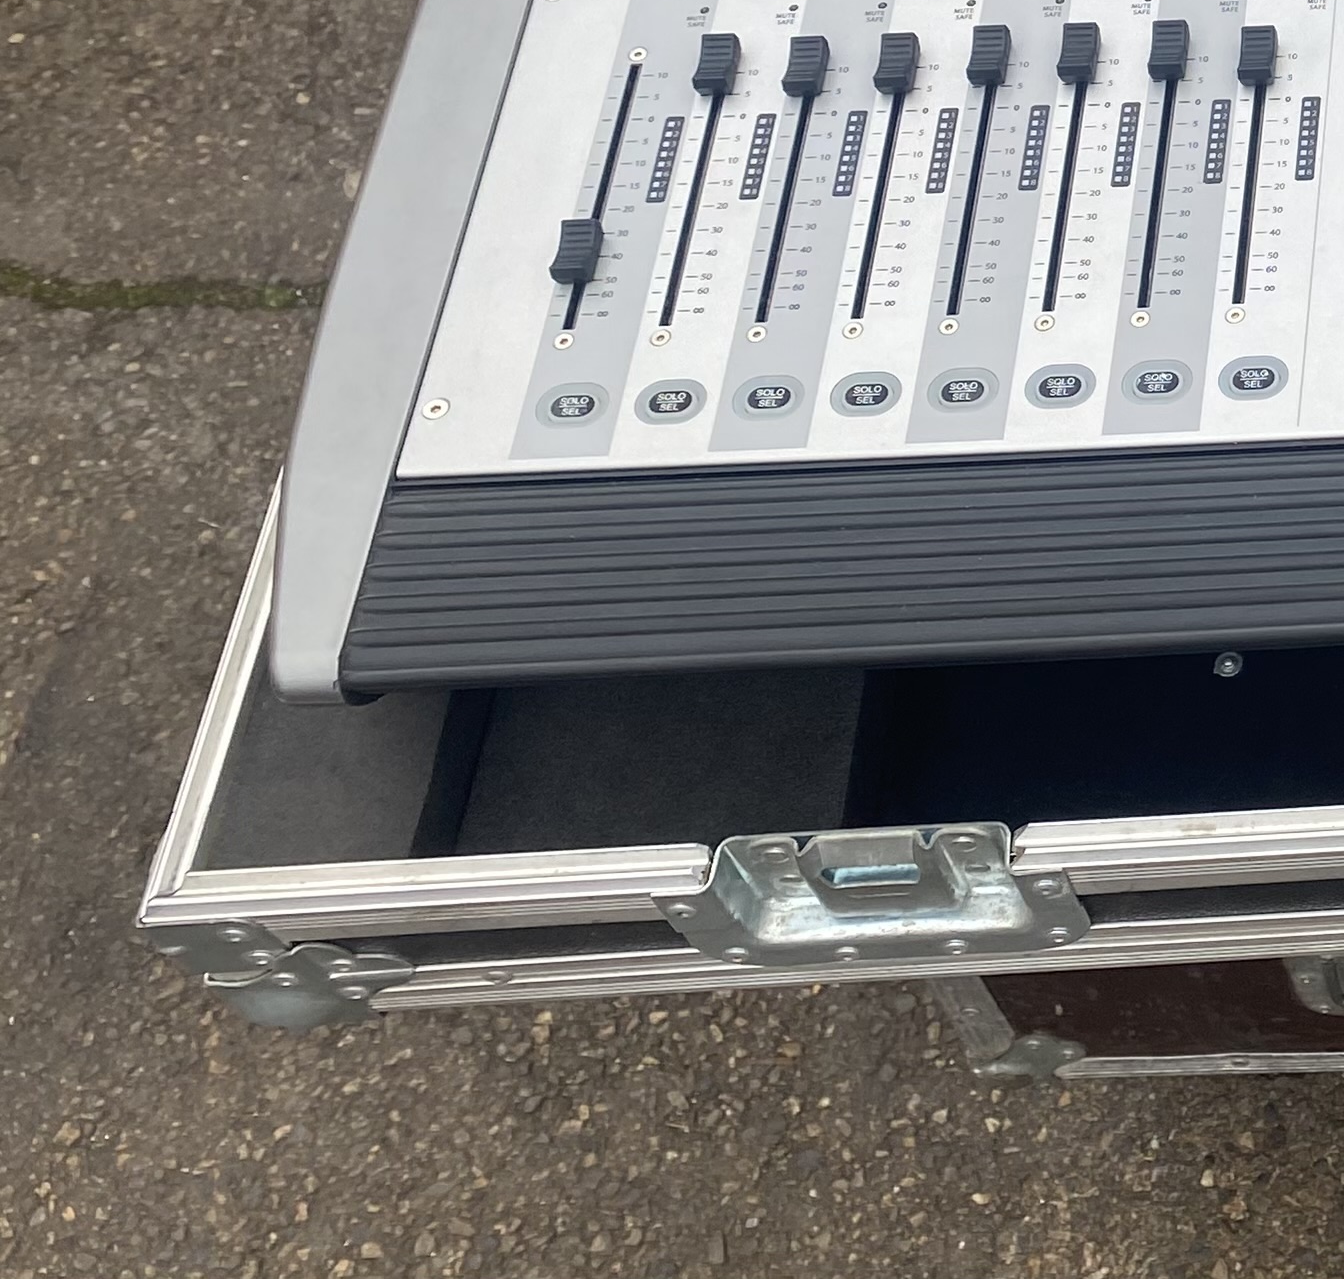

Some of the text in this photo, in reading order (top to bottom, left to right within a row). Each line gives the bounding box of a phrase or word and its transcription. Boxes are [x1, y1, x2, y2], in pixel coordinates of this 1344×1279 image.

[949, 381, 978, 390] SOLO
[1047, 378, 1075, 387] SOLO
[853, 385, 882, 394] SOLO
[1049, 387, 1069, 396] SEL
[657, 392, 686, 402] SOLO
[855, 395, 875, 404] SEL
[952, 392, 971, 401] SEL
[560, 397, 589, 406] SOLO
[561, 407, 581, 416] SEL
[659, 403, 679, 412] SEL
